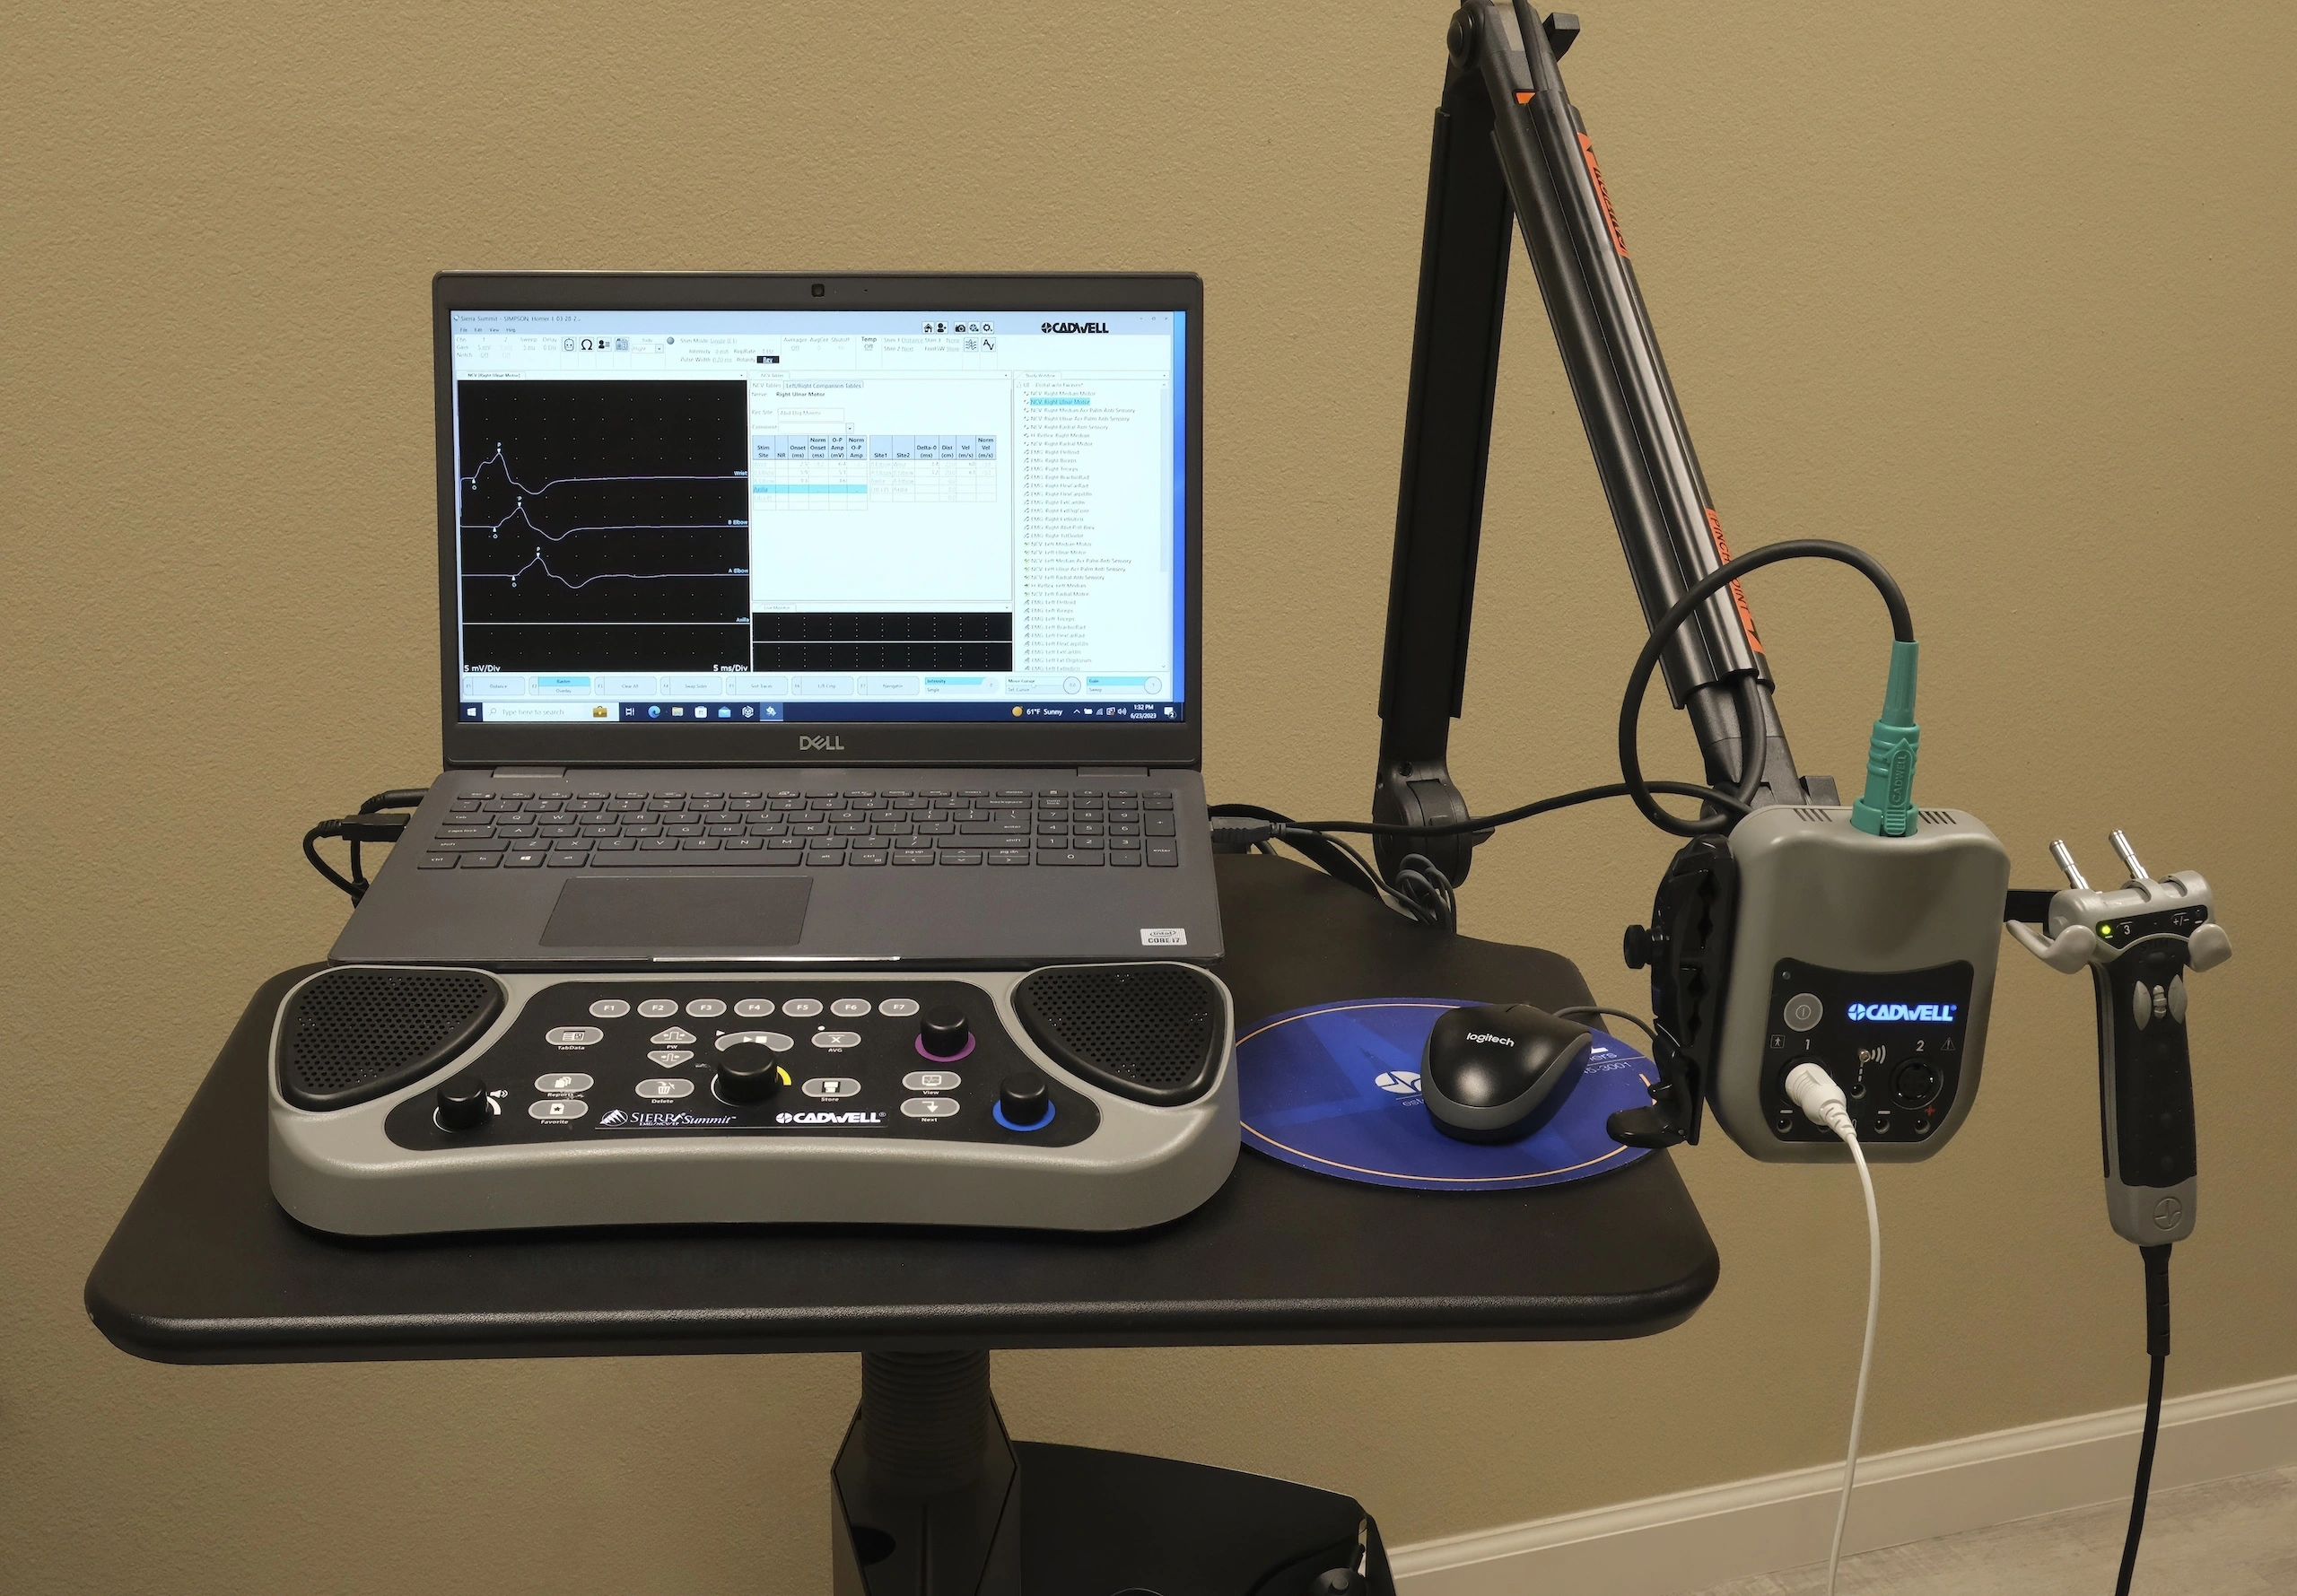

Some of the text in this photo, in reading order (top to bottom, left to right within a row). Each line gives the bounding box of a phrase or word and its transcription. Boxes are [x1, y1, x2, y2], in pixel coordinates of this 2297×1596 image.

[1052, 323, 1109, 334] CADWELL
[1731, 578, 1750, 614] OINT
[472, 665, 501, 673] mV/Div
[721, 665, 748, 673] ms/Div
[502, 708, 518, 716] Type
[1044, 708, 1063, 717] Sunny
[799, 735, 844, 750] DELL
[2124, 924, 2131, 936] 3
[1865, 1004, 1954, 1022] CADWELL
[1466, 1032, 1515, 1047] logitech
[1805, 1039, 1811, 1050] 1
[1916, 1040, 1925, 1051] 2
[793, 1112, 881, 1123] CADWELL
